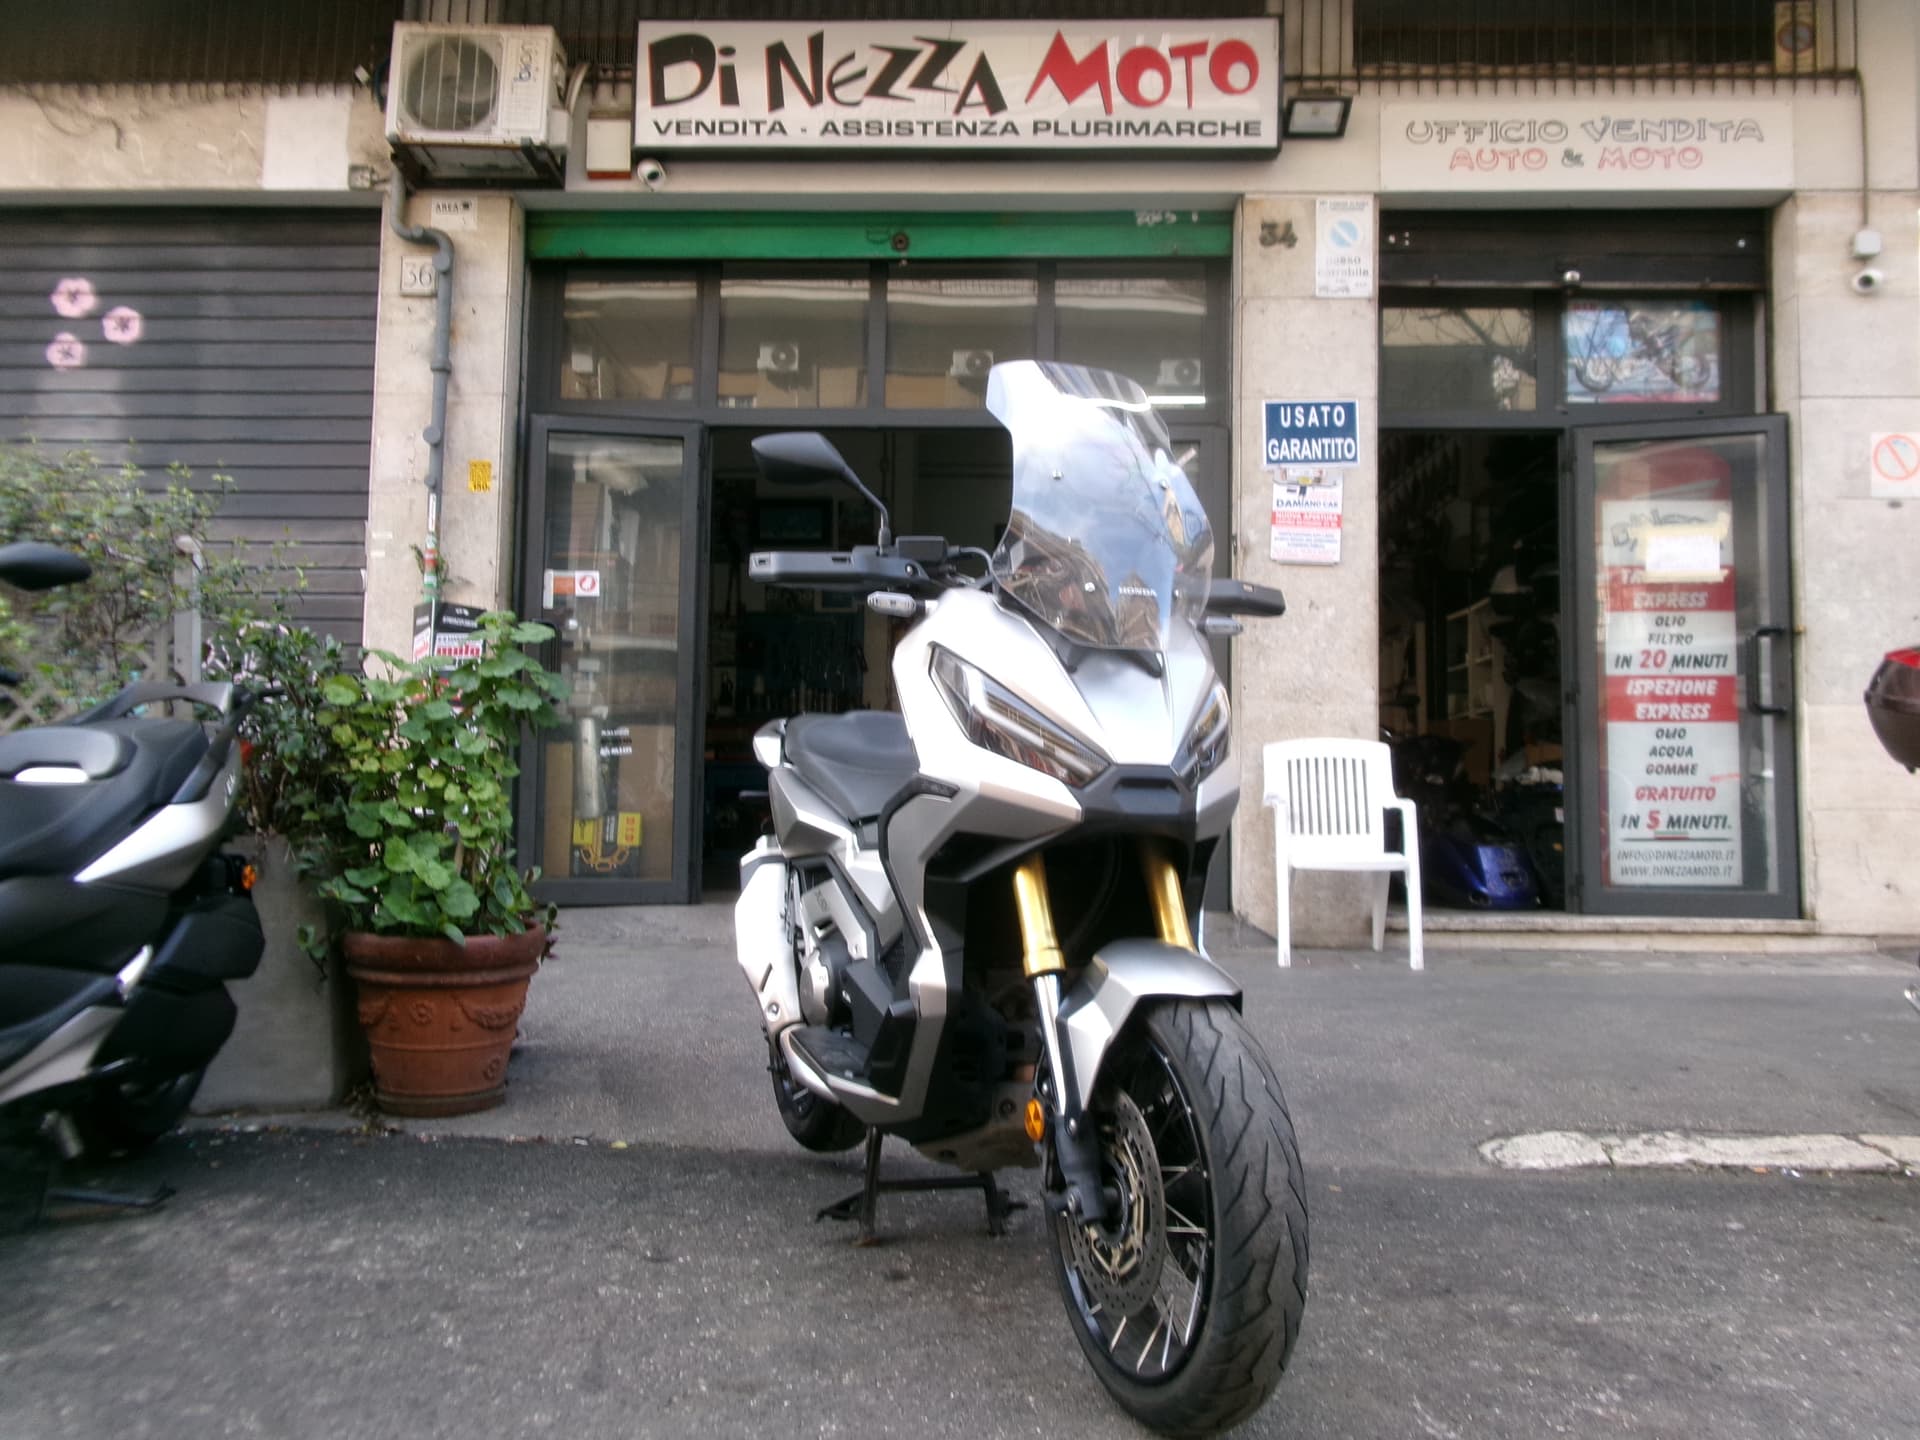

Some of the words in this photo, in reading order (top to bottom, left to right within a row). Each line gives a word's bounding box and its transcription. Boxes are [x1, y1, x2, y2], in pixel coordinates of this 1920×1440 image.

[648, 32, 739, 108] Di
[1025, 30, 1260, 116] MOTO
[653, 120, 787, 136] VENDITA
[820, 120, 1020, 138] ASSISTENZA
[1032, 120, 1262, 137] PLURIMARCHE
[1406, 119, 1568, 145] UFFICIO
[1581, 117, 1764, 143] VENDITA
[1449, 147, 1548, 171] AUTO
[1561, 149, 1584, 168] &
[1599, 147, 1703, 170] MOTO
[1280, 406, 1346, 428] USATO
[1268, 437, 1356, 460] GARANTITO
[1118, 586, 1157, 597] HONDA
[1633, 592, 1708, 608] EXPRESS
[1656, 616, 1686, 627] OLIO
[1648, 633, 1694, 645] FILTRO
[1615, 654, 1632, 668] IN
[1640, 650, 1666, 668] 20
[1671, 654, 1728, 669] MINUTI
[1626, 680, 1718, 696] ISPEZIONE
[1635, 704, 1711, 720] EXPRESS
[1656, 728, 1687, 740] OLIO
[1649, 747, 1694, 759] ACQUA
[1646, 764, 1698, 776] GOMME
[1635, 786, 1716, 801] GRATUITO
[1621, 815, 1640, 829] IN
[1646, 811, 1660, 830] 5
